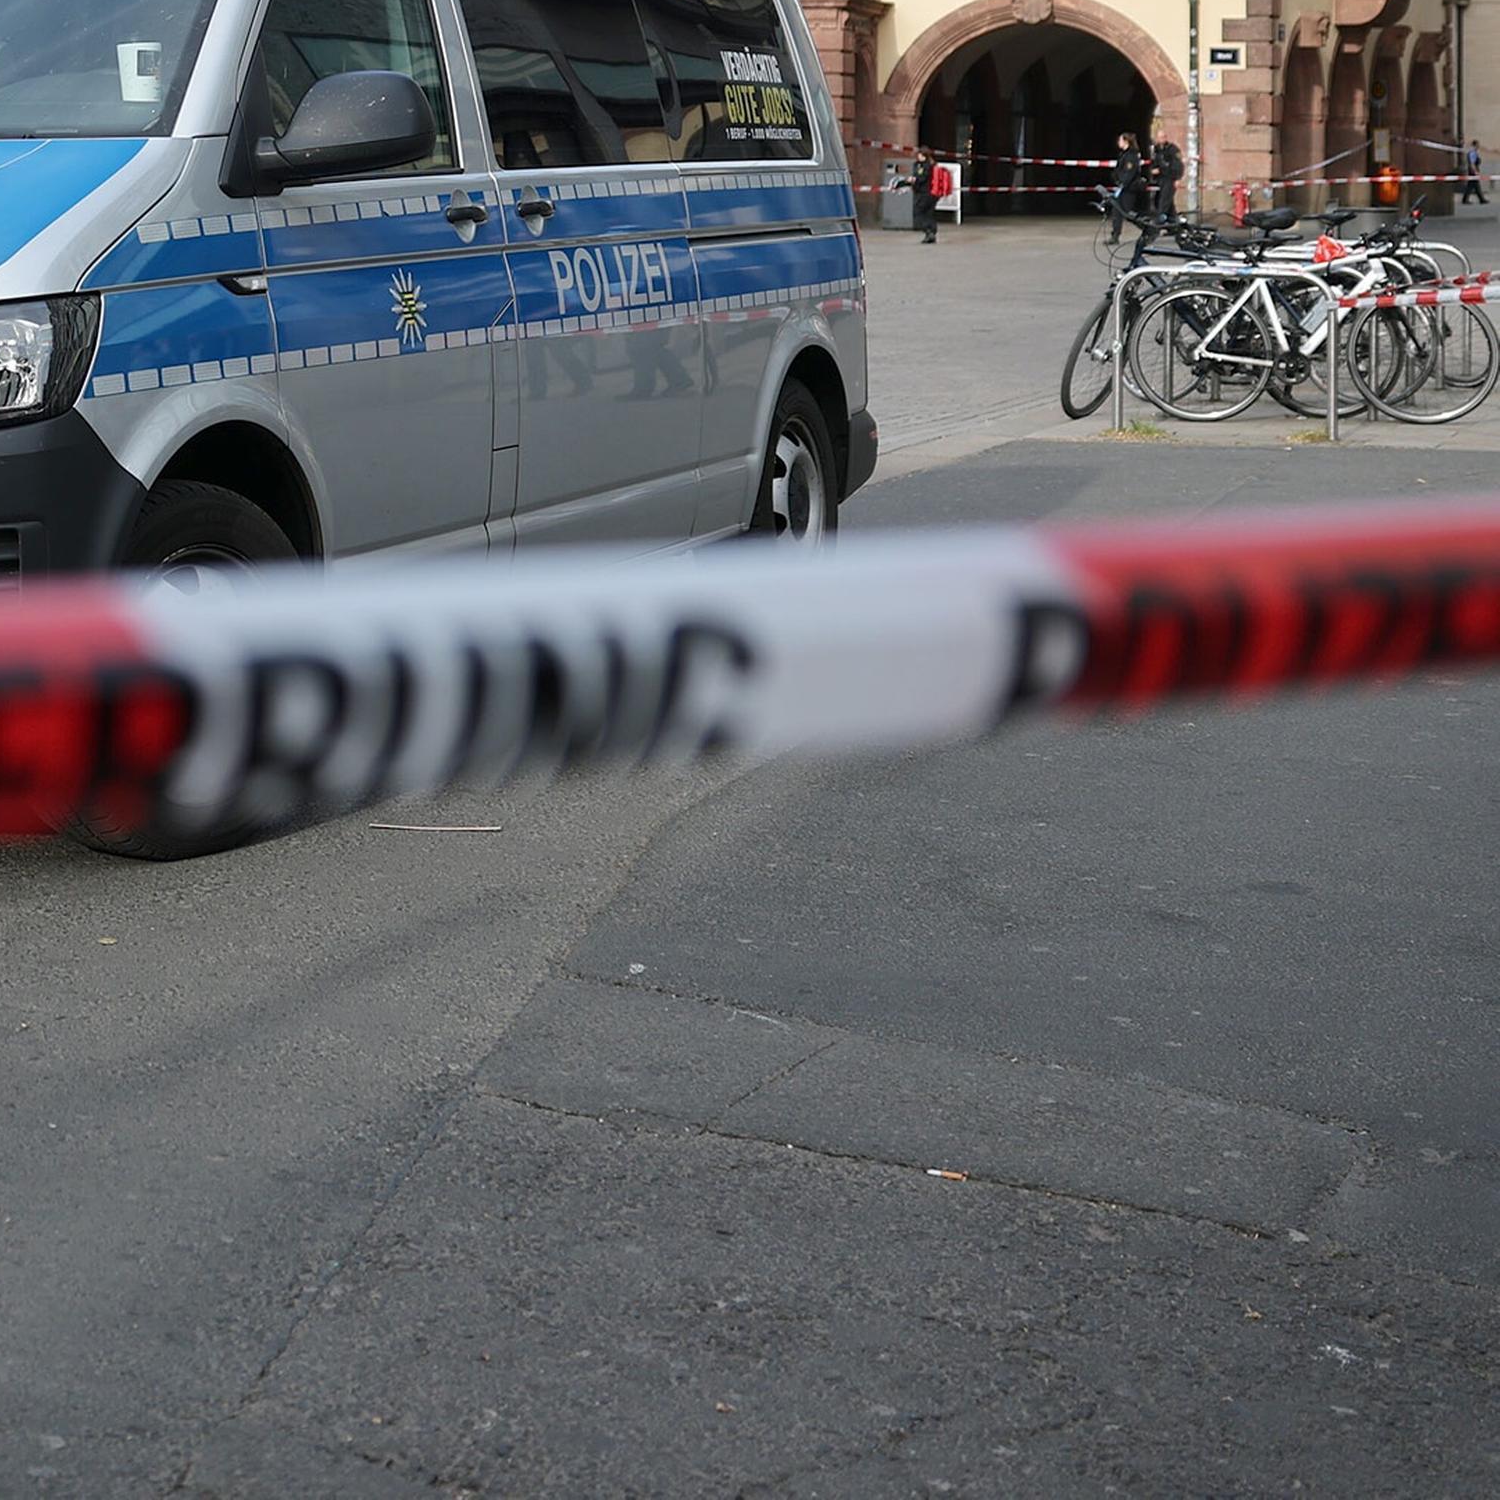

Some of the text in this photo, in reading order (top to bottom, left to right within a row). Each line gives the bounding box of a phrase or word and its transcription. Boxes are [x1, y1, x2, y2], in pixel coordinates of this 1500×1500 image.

[720, 46, 783, 84] VERDÄCHTIG
[724, 84, 797, 125] GUTE JOBS!
[548, 242, 674, 315] POLIZEI
